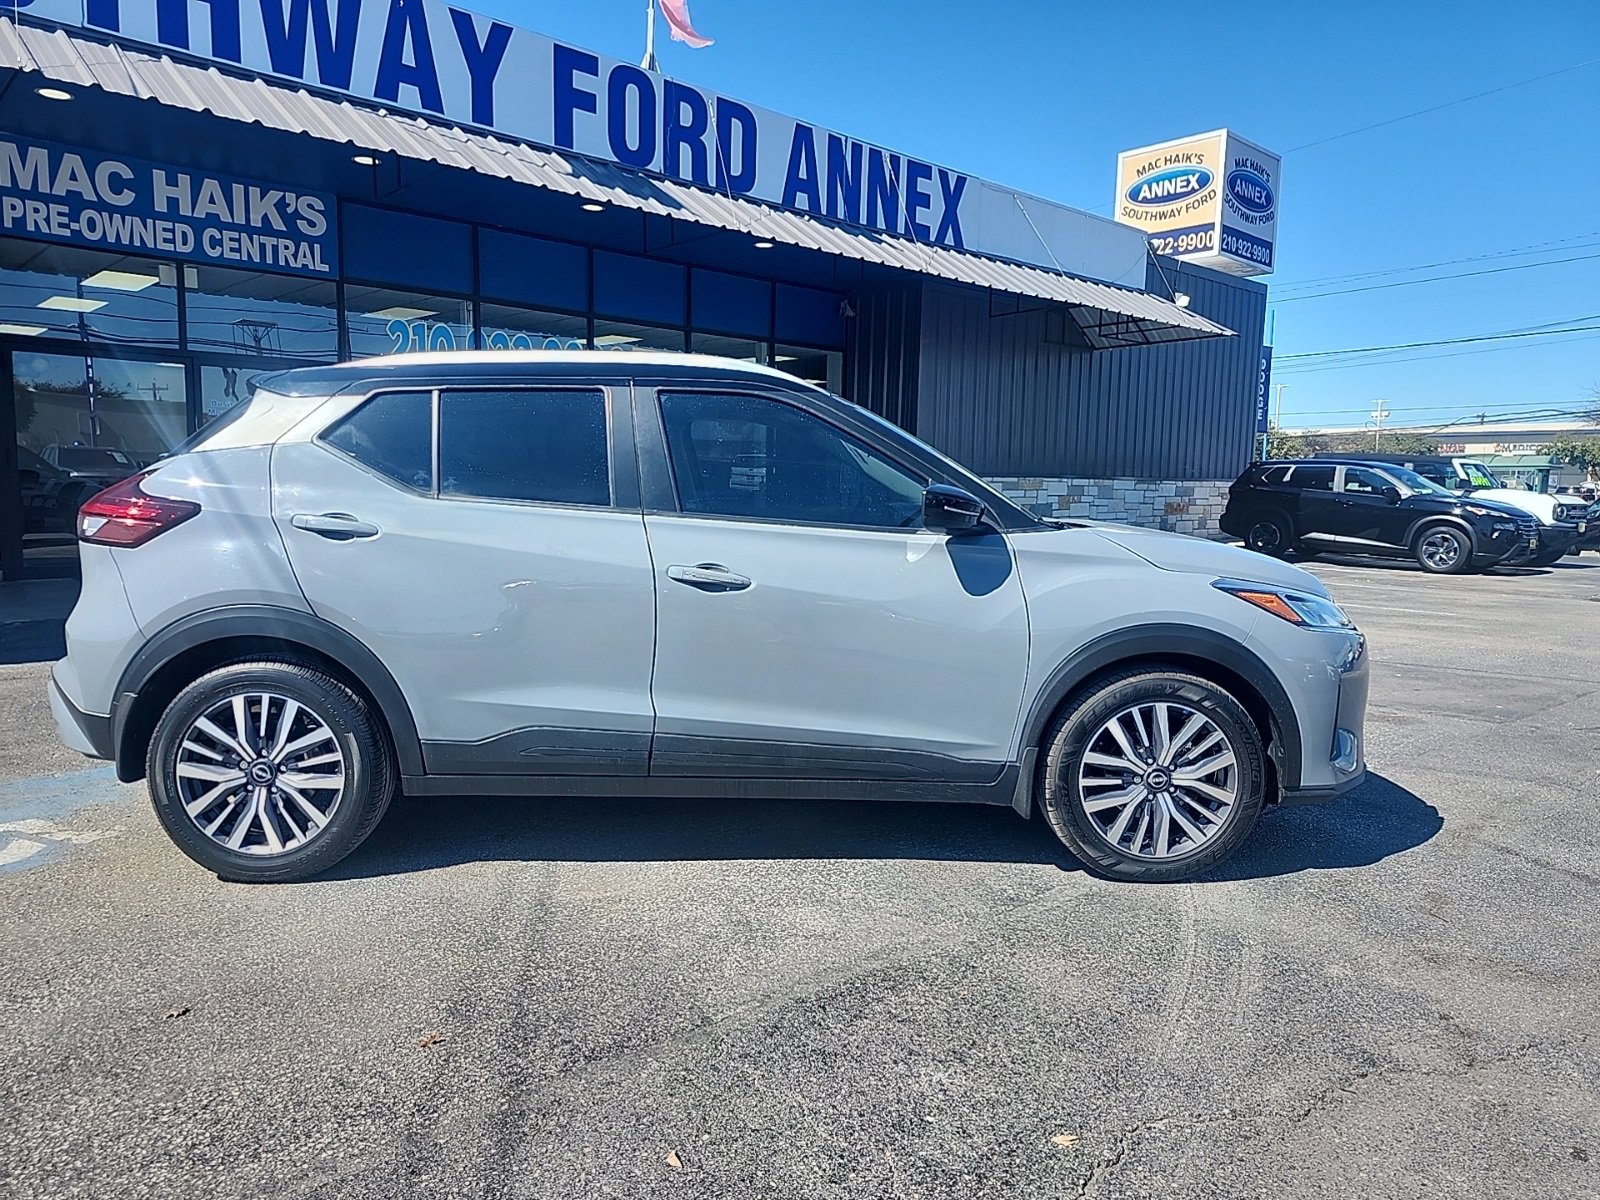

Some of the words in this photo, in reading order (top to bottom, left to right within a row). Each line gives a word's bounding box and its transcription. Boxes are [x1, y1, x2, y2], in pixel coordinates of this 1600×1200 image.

[553, 43, 757, 193] FORD
[782, 122, 967, 249] ANNEX
[1136, 158, 1162, 178] MAC
[1164, 153, 1205, 166] HAIK'S
[1234, 157, 1249, 170] MAC
[1249, 159, 1271, 184] HAIK'S
[0, 141, 136, 206] MAC
[152, 169, 327, 237] HAIK'S
[1138, 172, 1200, 201] ANNEX
[1234, 178, 1267, 206] ANNEX
[1121, 205, 1183, 222] SOUTHWAY
[1185, 188, 1217, 214] FORD
[1224, 193, 1258, 225] SOUTHWAY
[1258, 210, 1275, 225] FORD
[2, 196, 195, 253] PRE-OWNED
[202, 228, 330, 272] CENTRAL
